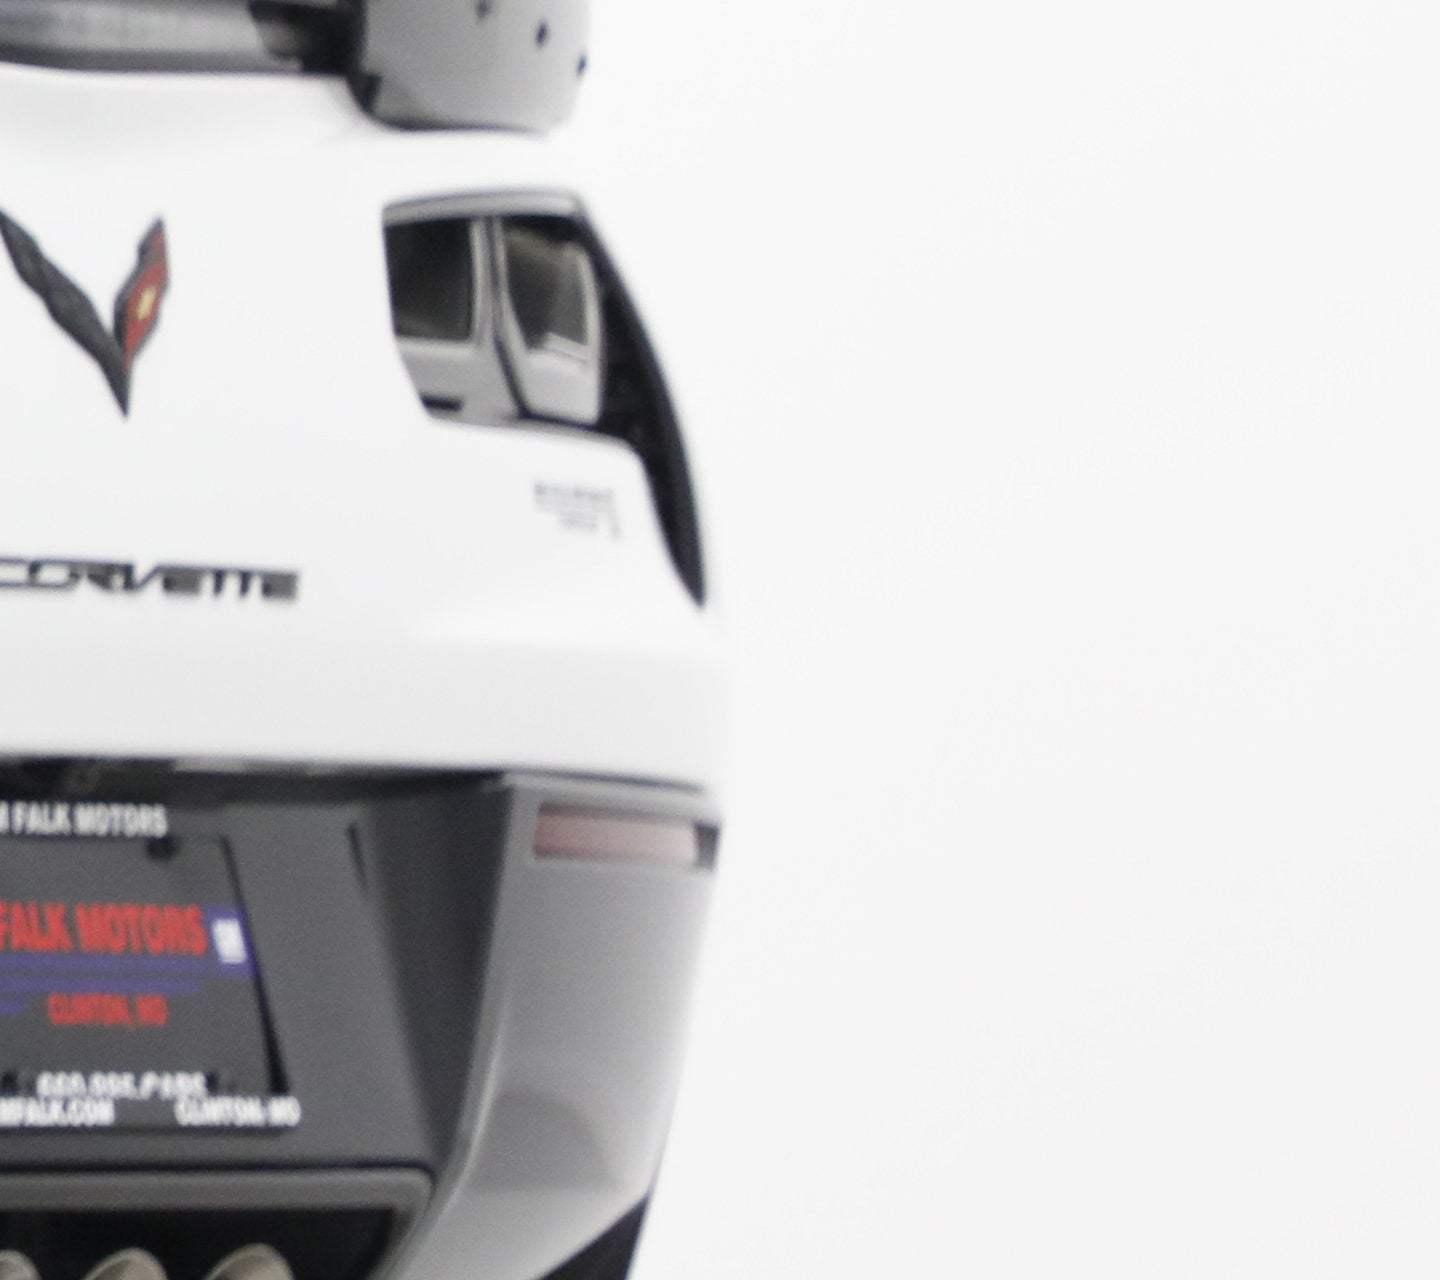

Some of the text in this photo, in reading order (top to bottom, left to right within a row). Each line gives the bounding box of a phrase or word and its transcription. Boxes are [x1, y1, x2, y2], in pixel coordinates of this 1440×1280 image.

[11, 801, 72, 835] FALK
[74, 802, 169, 837] MOTORS
[74, 903, 209, 956] MOTORS
[137, 994, 169, 1027] MO
